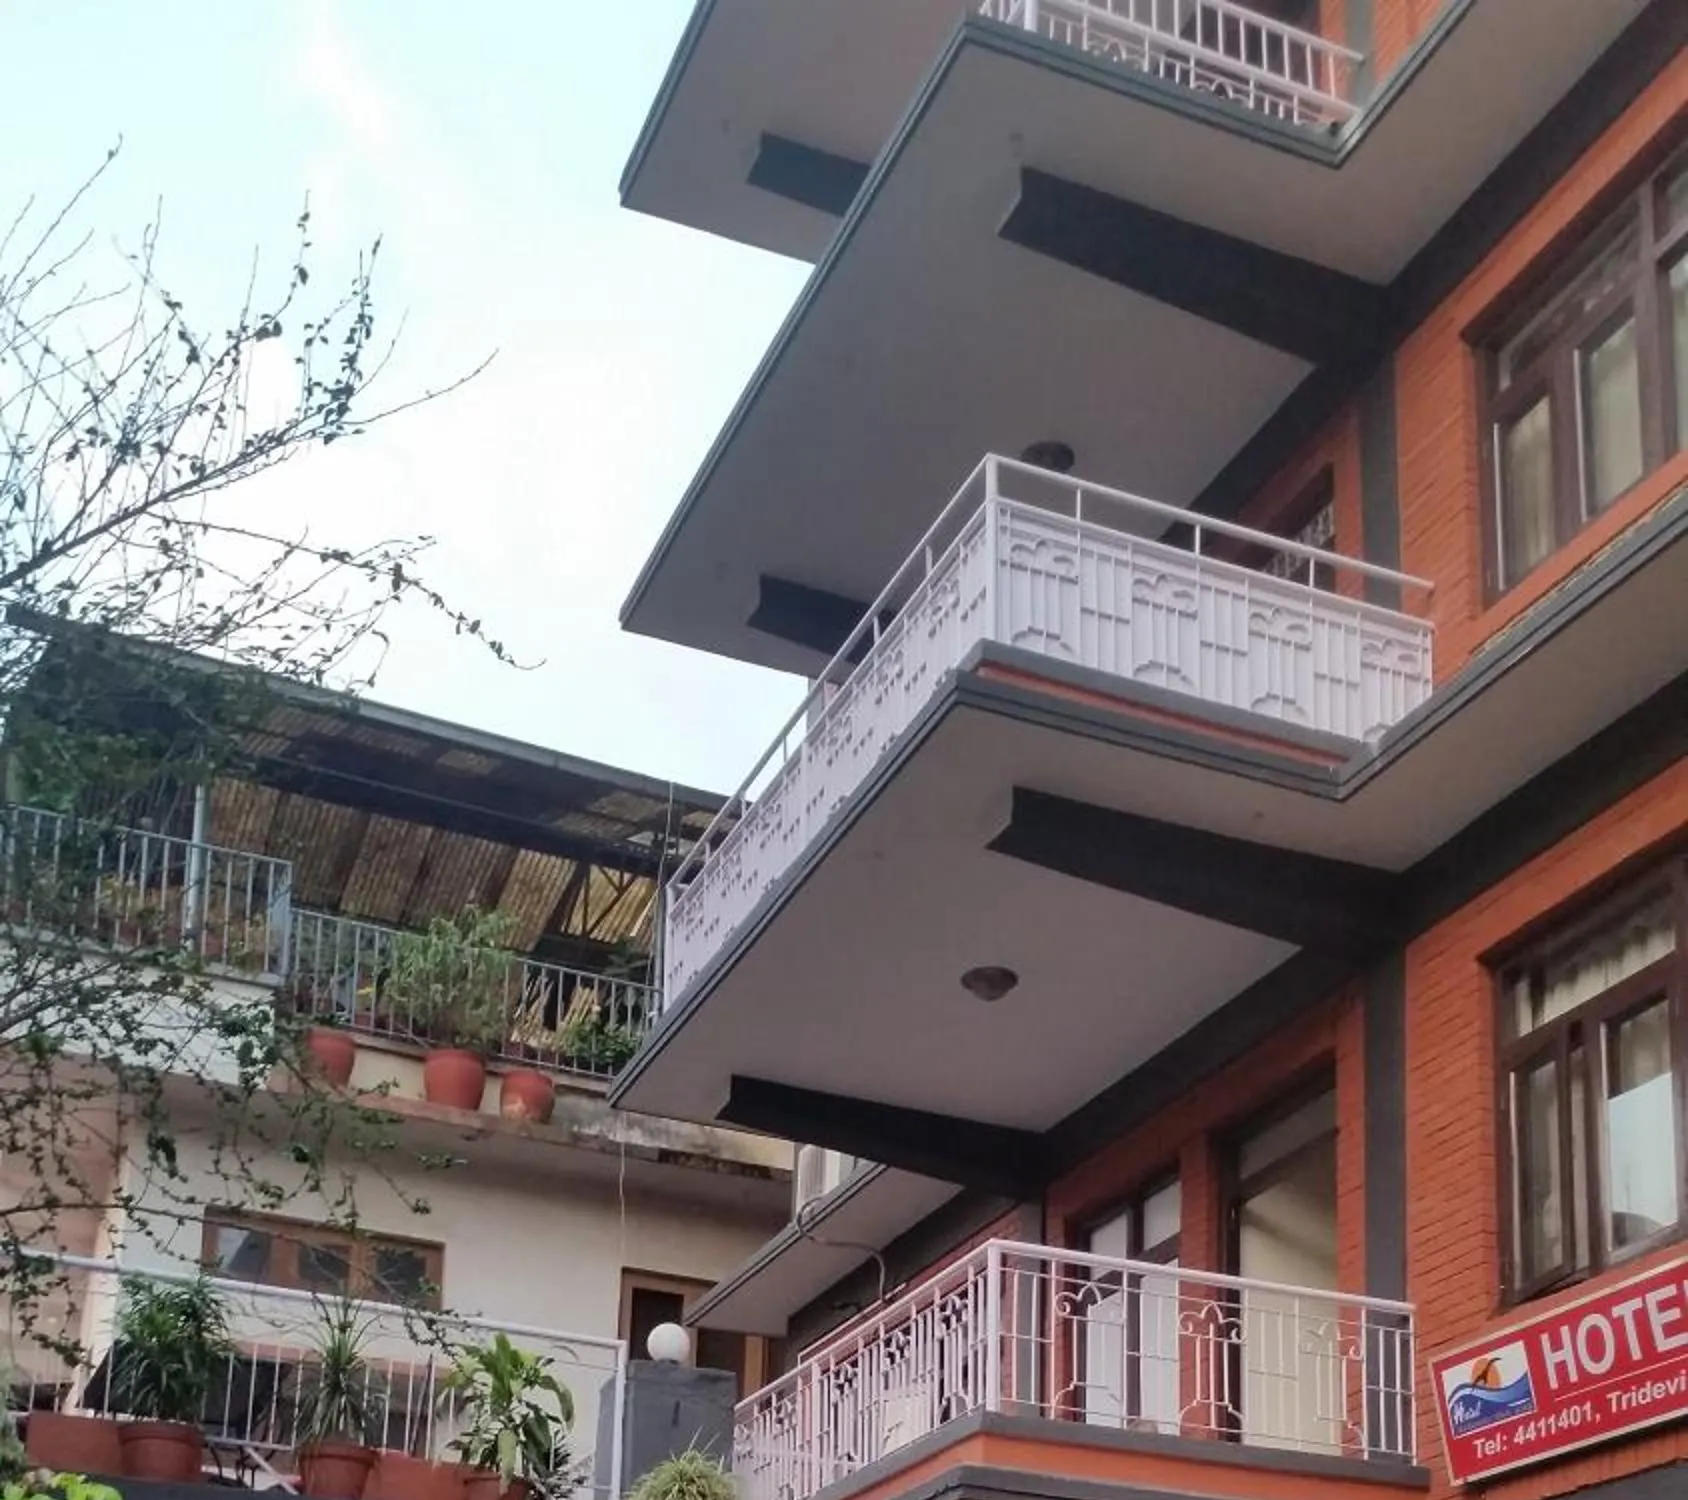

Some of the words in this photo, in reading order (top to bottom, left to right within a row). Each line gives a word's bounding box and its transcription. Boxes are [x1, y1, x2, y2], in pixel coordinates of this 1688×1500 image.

[1540, 1279, 1688, 1390] HOTE
[1473, 1430, 1507, 1458] Tel:
[1513, 1402, 1600, 1446] 4411401,
[1606, 1369, 1688, 1413] Tridevi
